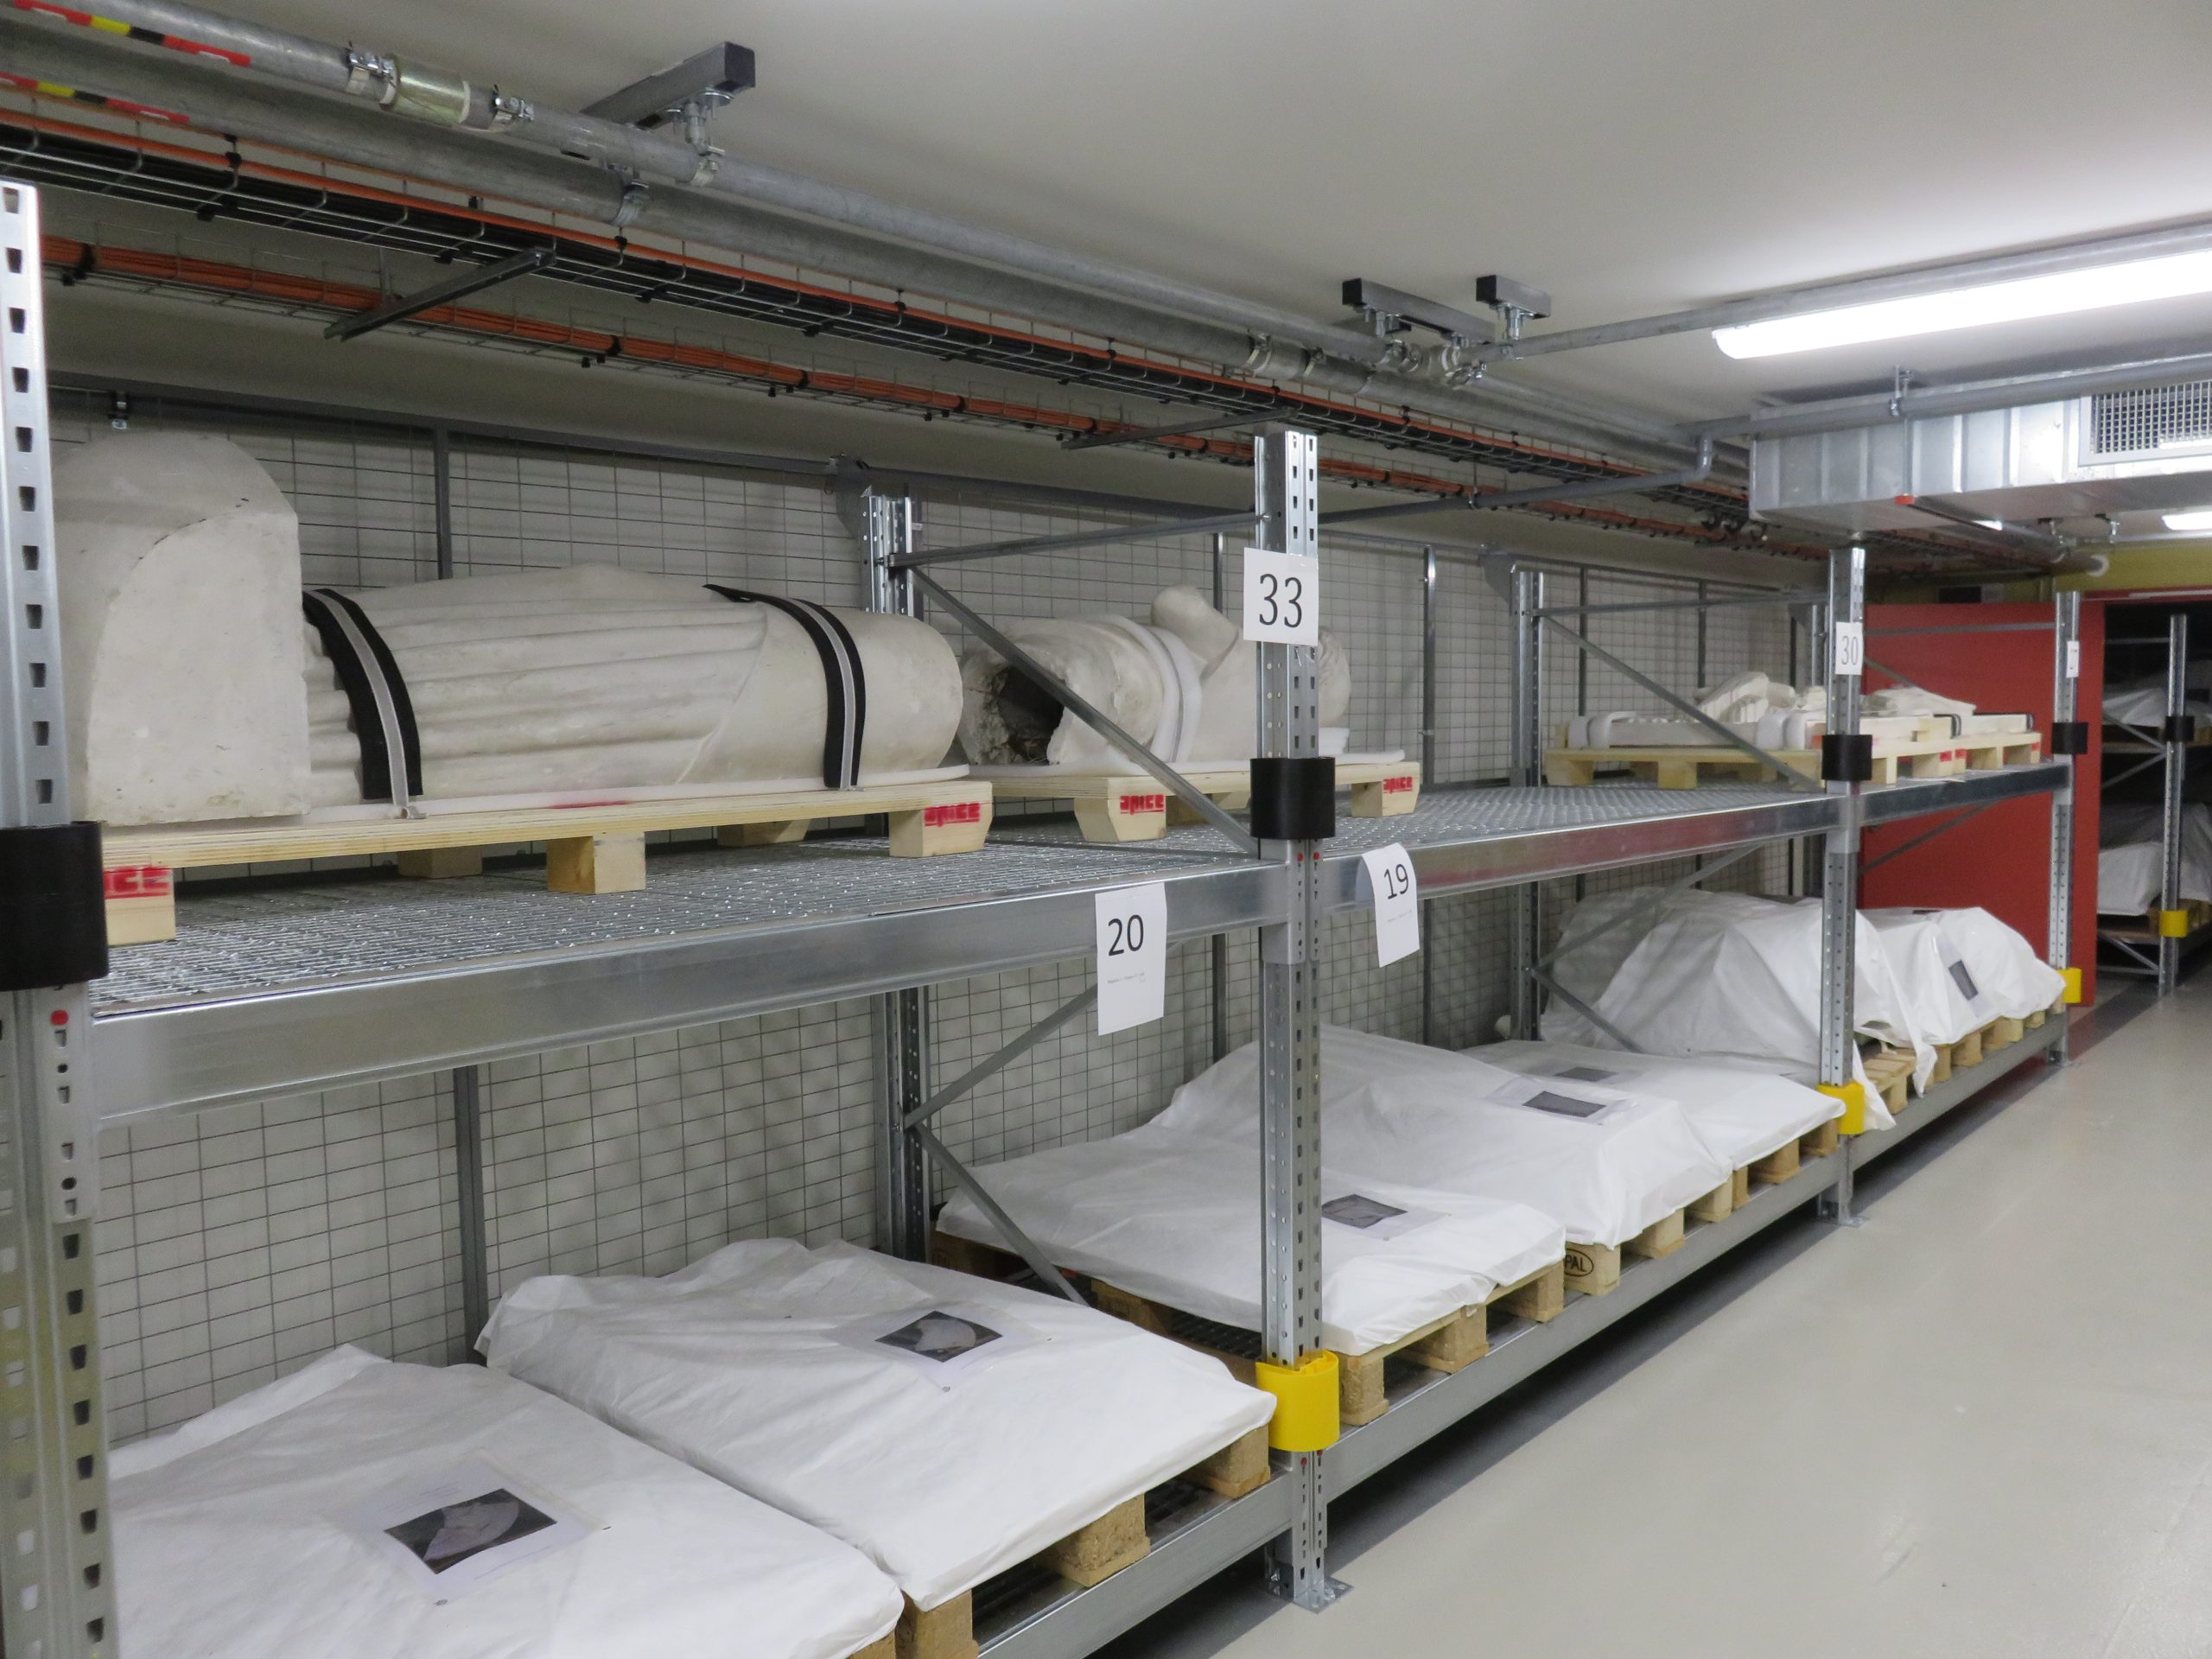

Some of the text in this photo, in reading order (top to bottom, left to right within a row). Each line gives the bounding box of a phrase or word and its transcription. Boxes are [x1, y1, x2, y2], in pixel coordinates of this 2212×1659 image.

[1259, 573, 1302, 628] 33
[1841, 635, 1859, 665] 30
[1384, 863, 1409, 899] 19
[1108, 914, 1144, 957] 20
[1564, 1254, 1587, 1272] PAL
